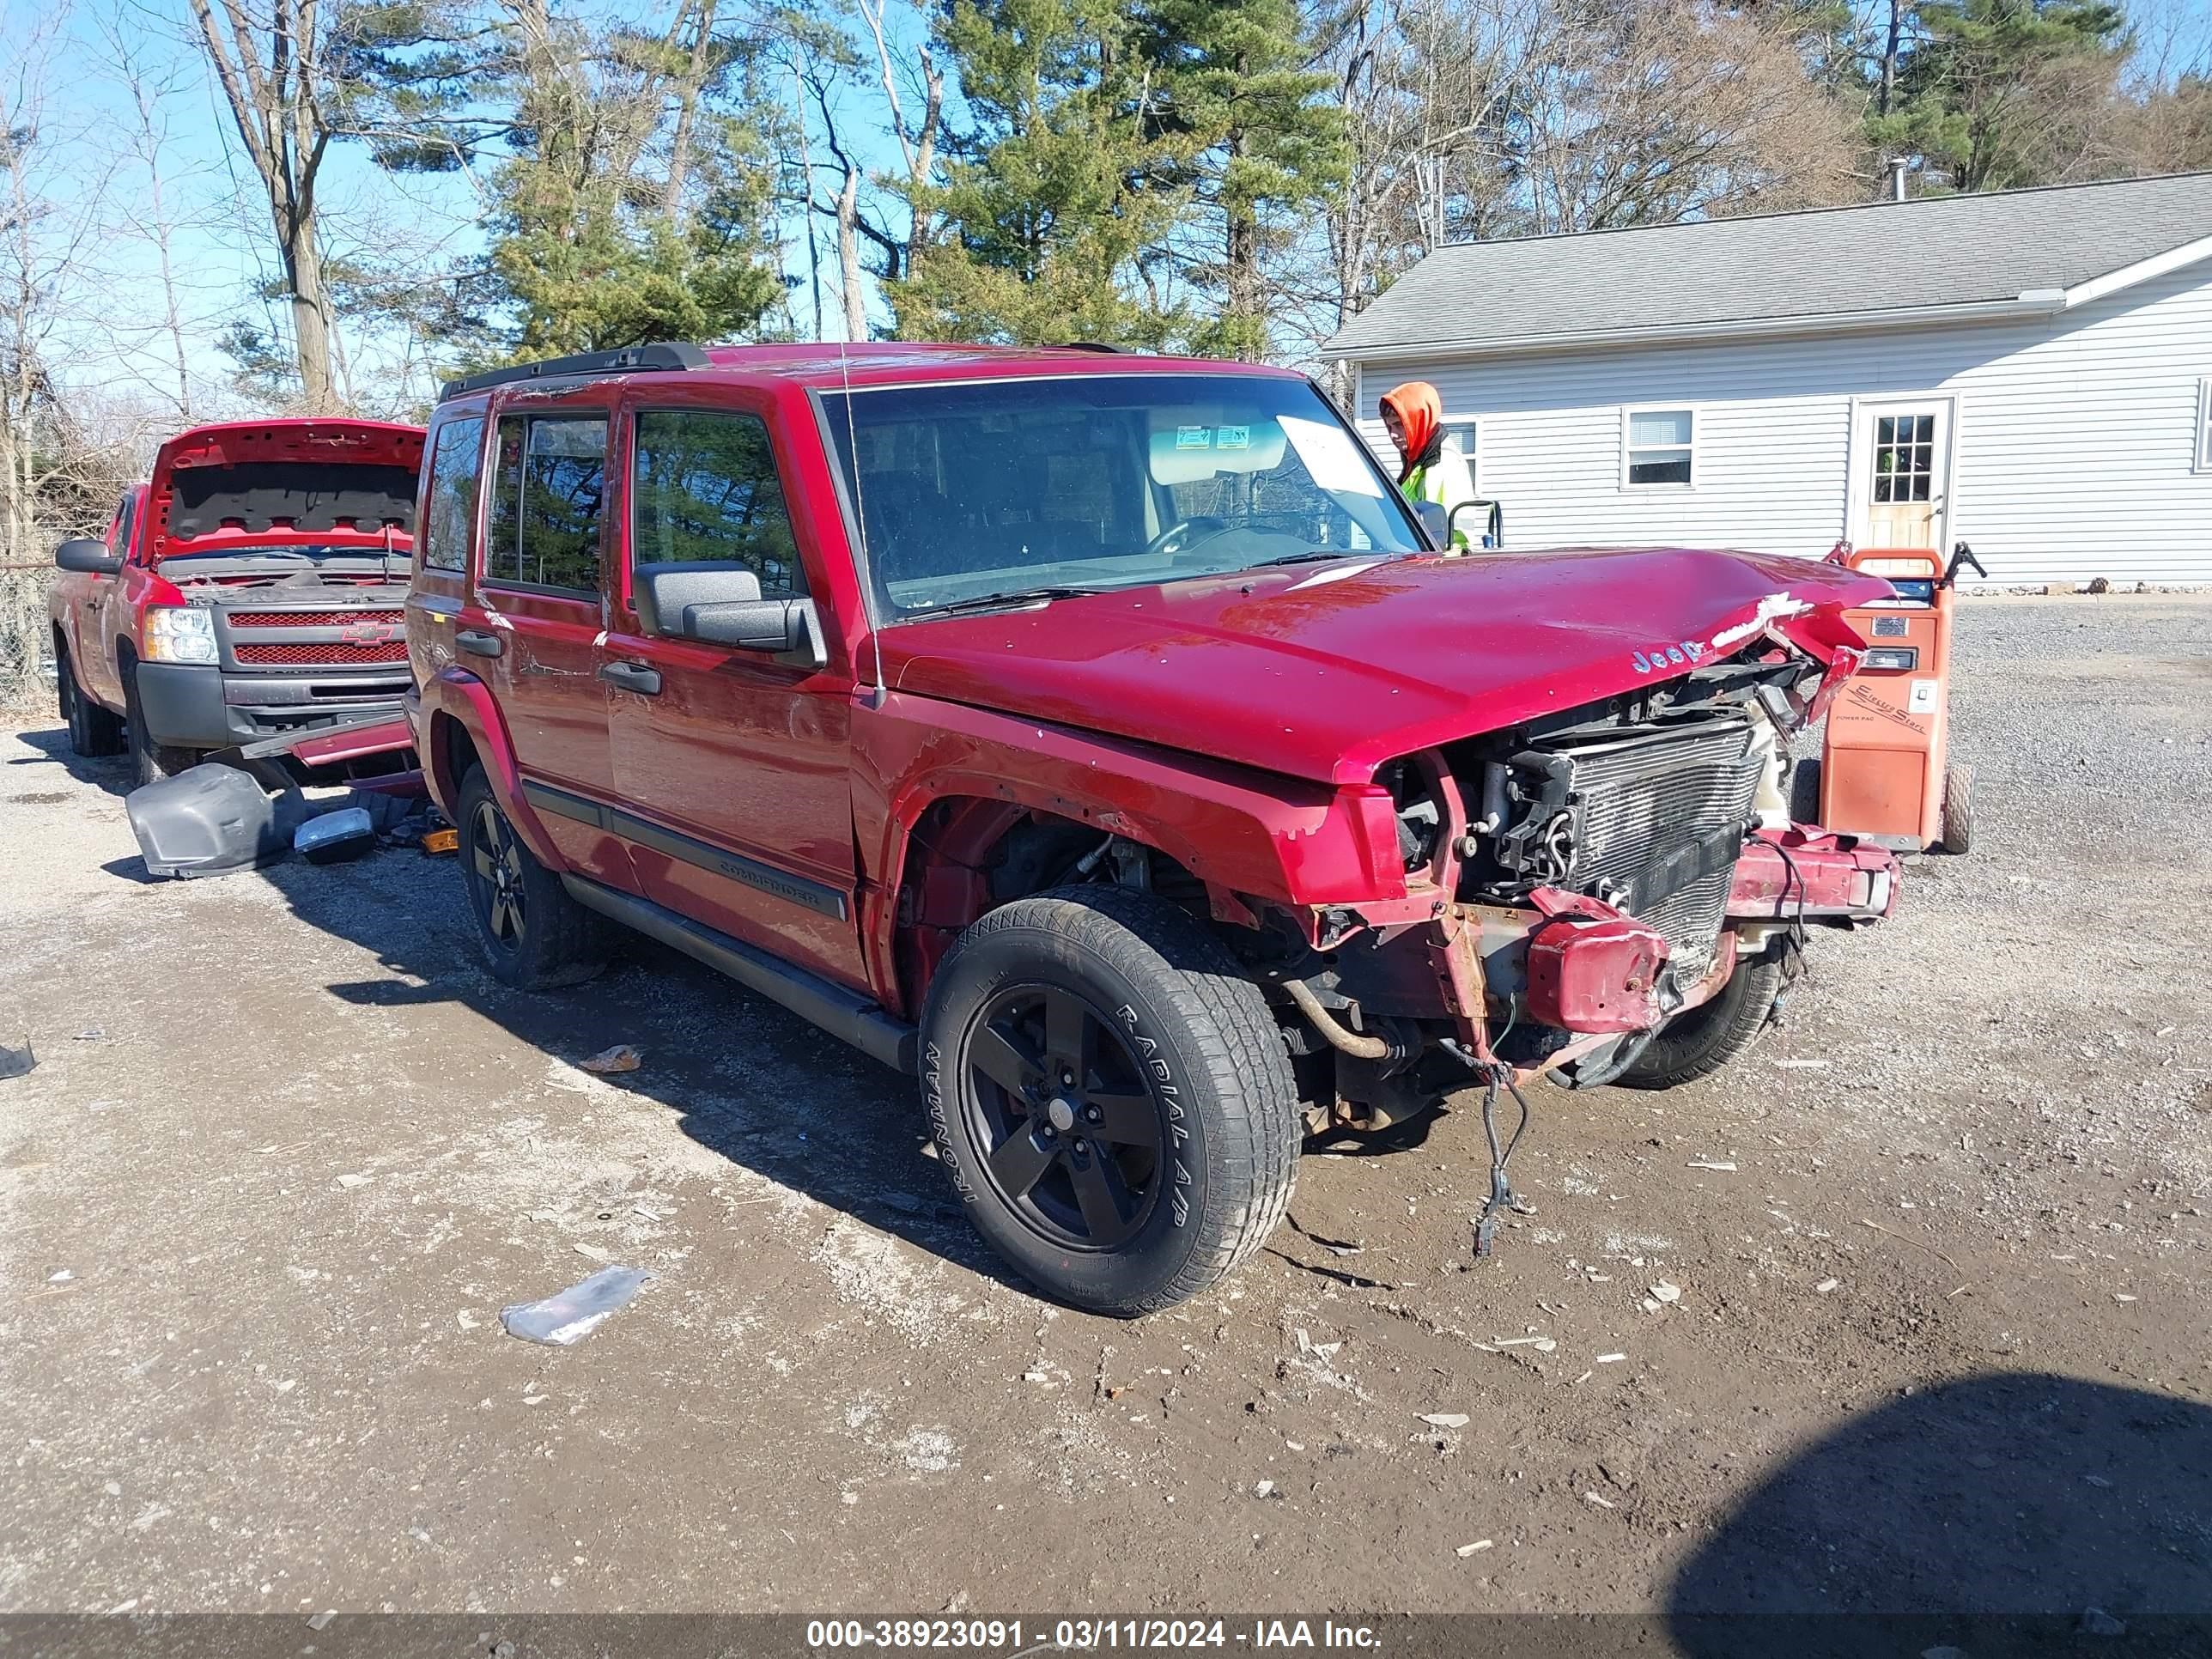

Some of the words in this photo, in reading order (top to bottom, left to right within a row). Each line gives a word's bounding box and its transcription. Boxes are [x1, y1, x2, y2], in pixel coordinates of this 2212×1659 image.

[1632, 641, 1703, 674] Jeep
[1856, 684, 1896, 712] Electro
[1892, 708, 1926, 732] Start
[925, 1041, 979, 1204] IRONMAN
[1116, 1003, 1189, 1150] RADIAL
